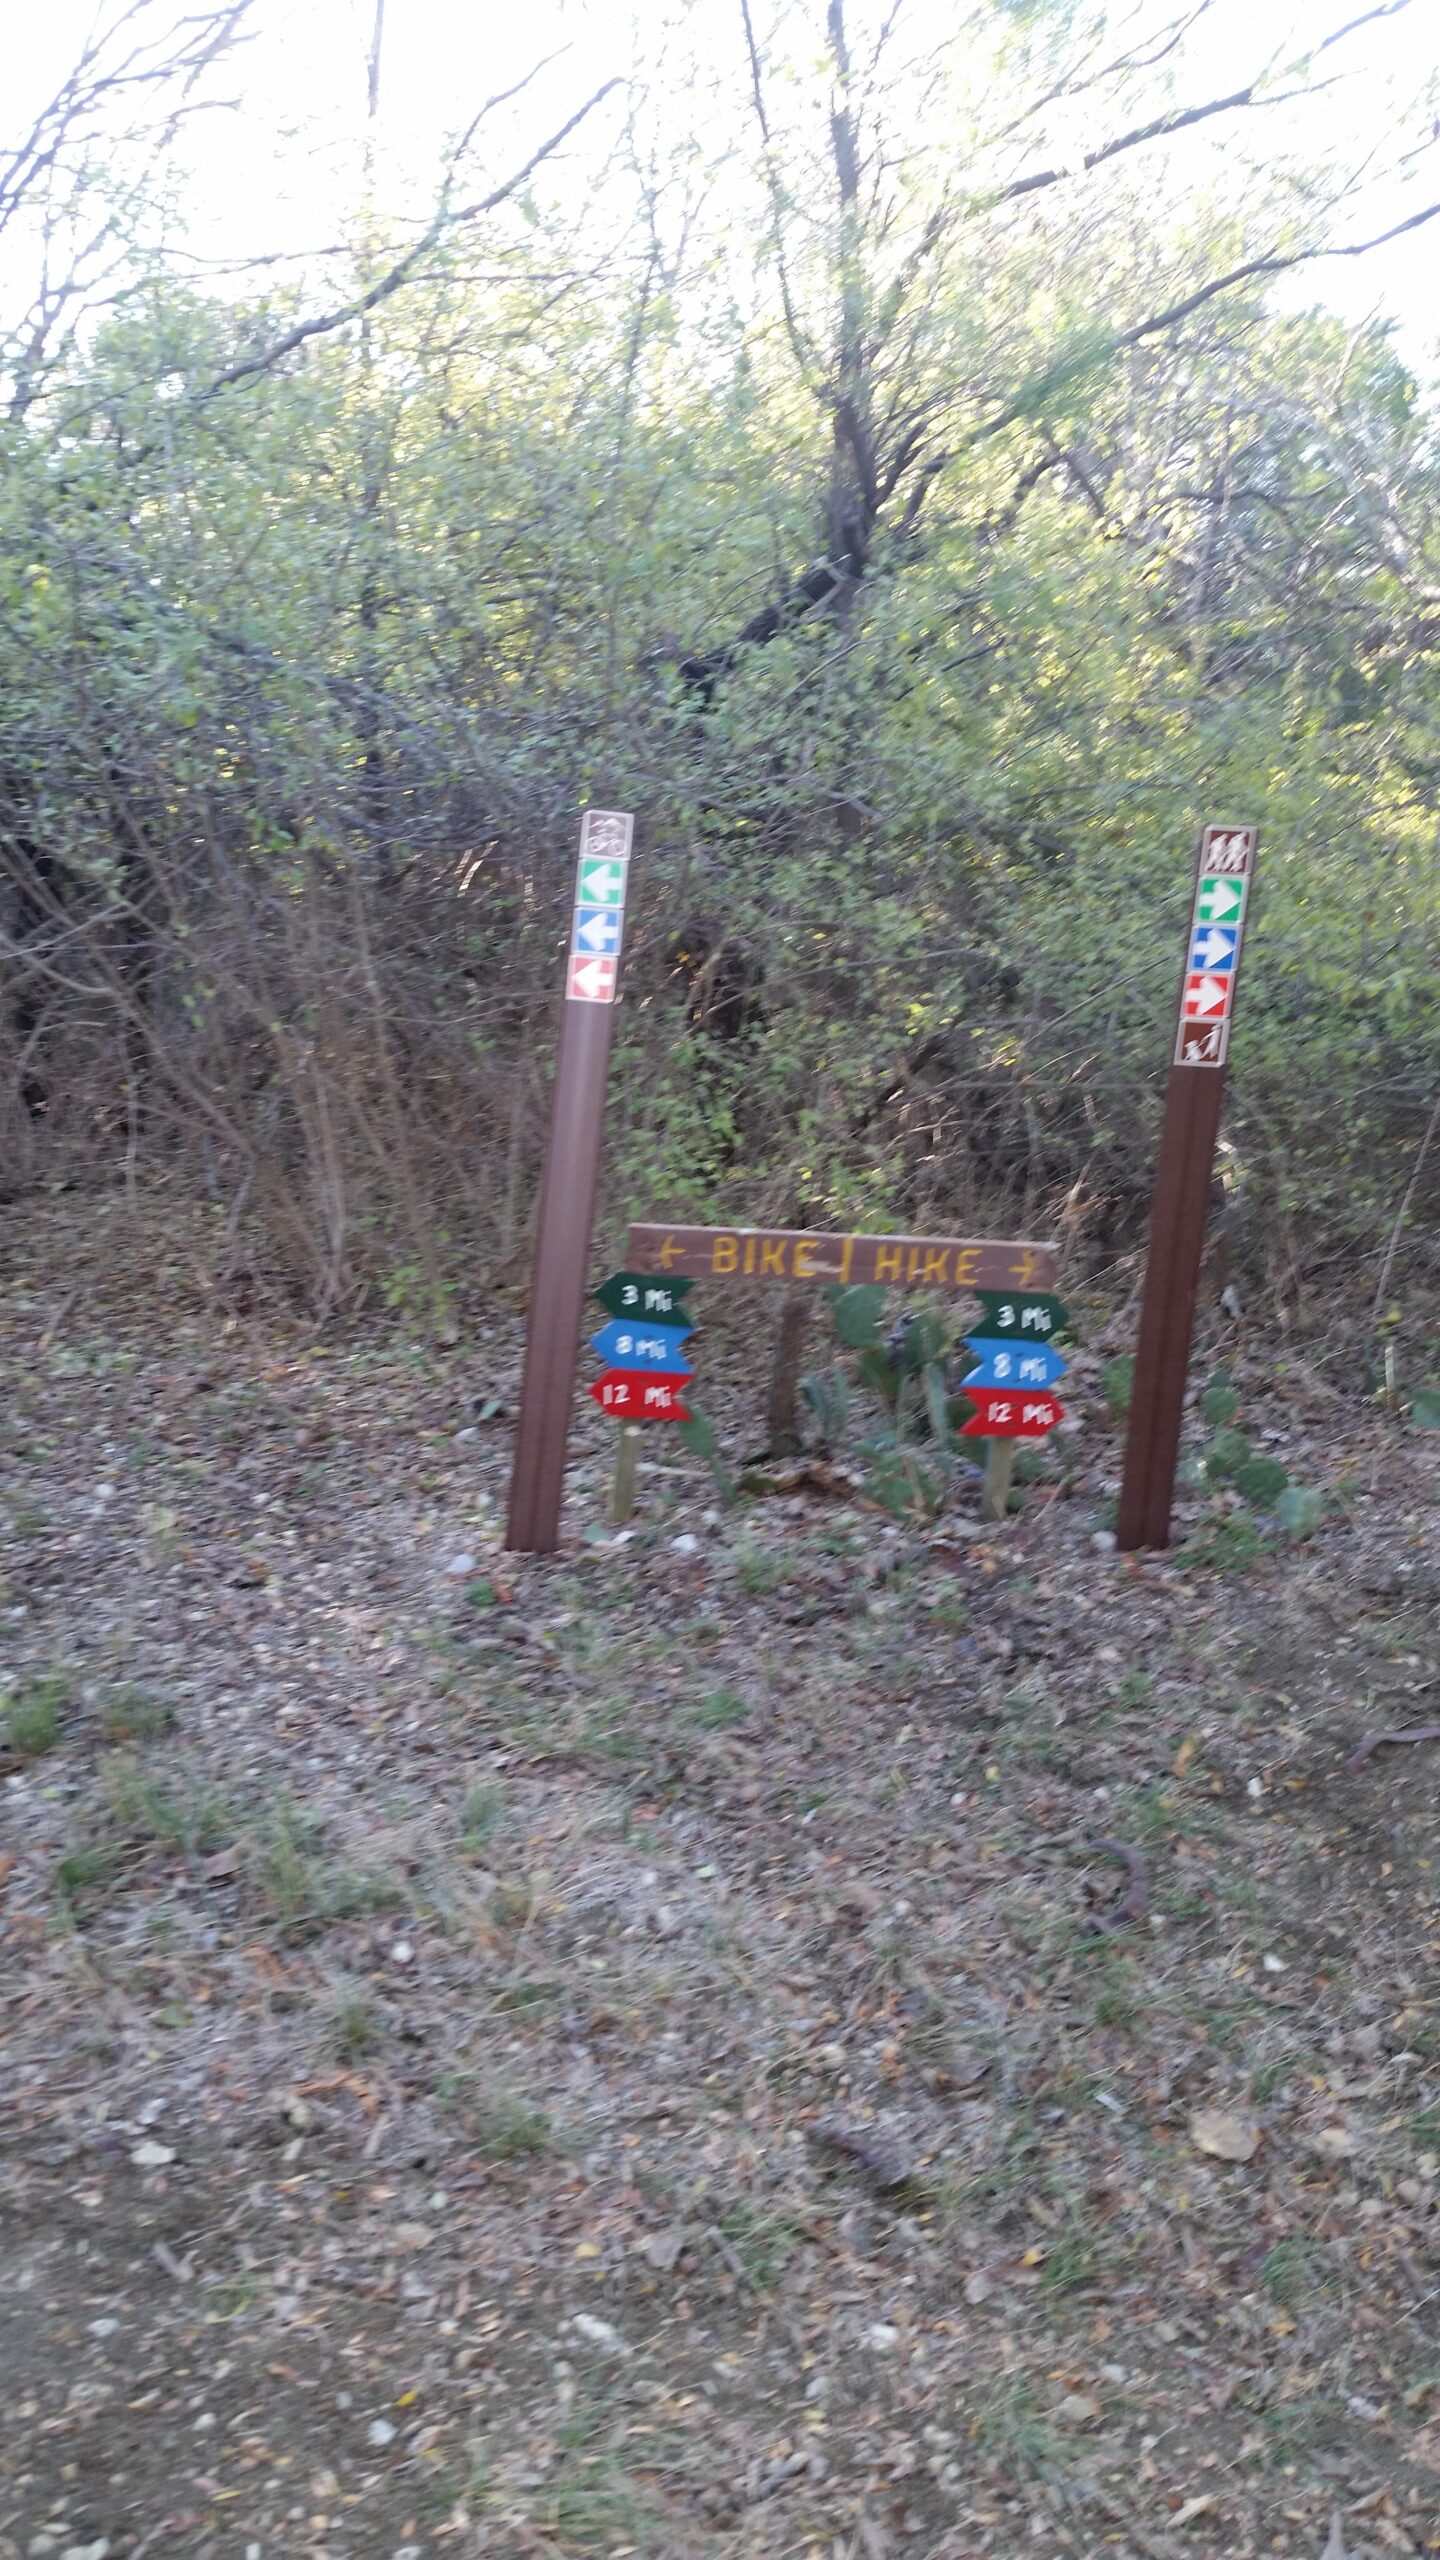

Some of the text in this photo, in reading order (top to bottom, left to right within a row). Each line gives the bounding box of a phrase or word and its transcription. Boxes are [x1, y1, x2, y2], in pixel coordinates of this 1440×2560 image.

[712, 1235, 983, 1285] BIKE HIKE
[621, 1284, 673, 1312] 3 Mi
[996, 1304, 1052, 1332] 3 Mi
[615, 1334, 667, 1360] 8 Mi
[993, 1352, 1048, 1382] 8 Mi
[602, 1383, 672, 1408] 12 Mi
[987, 1401, 1054, 1425] 12 Mi
